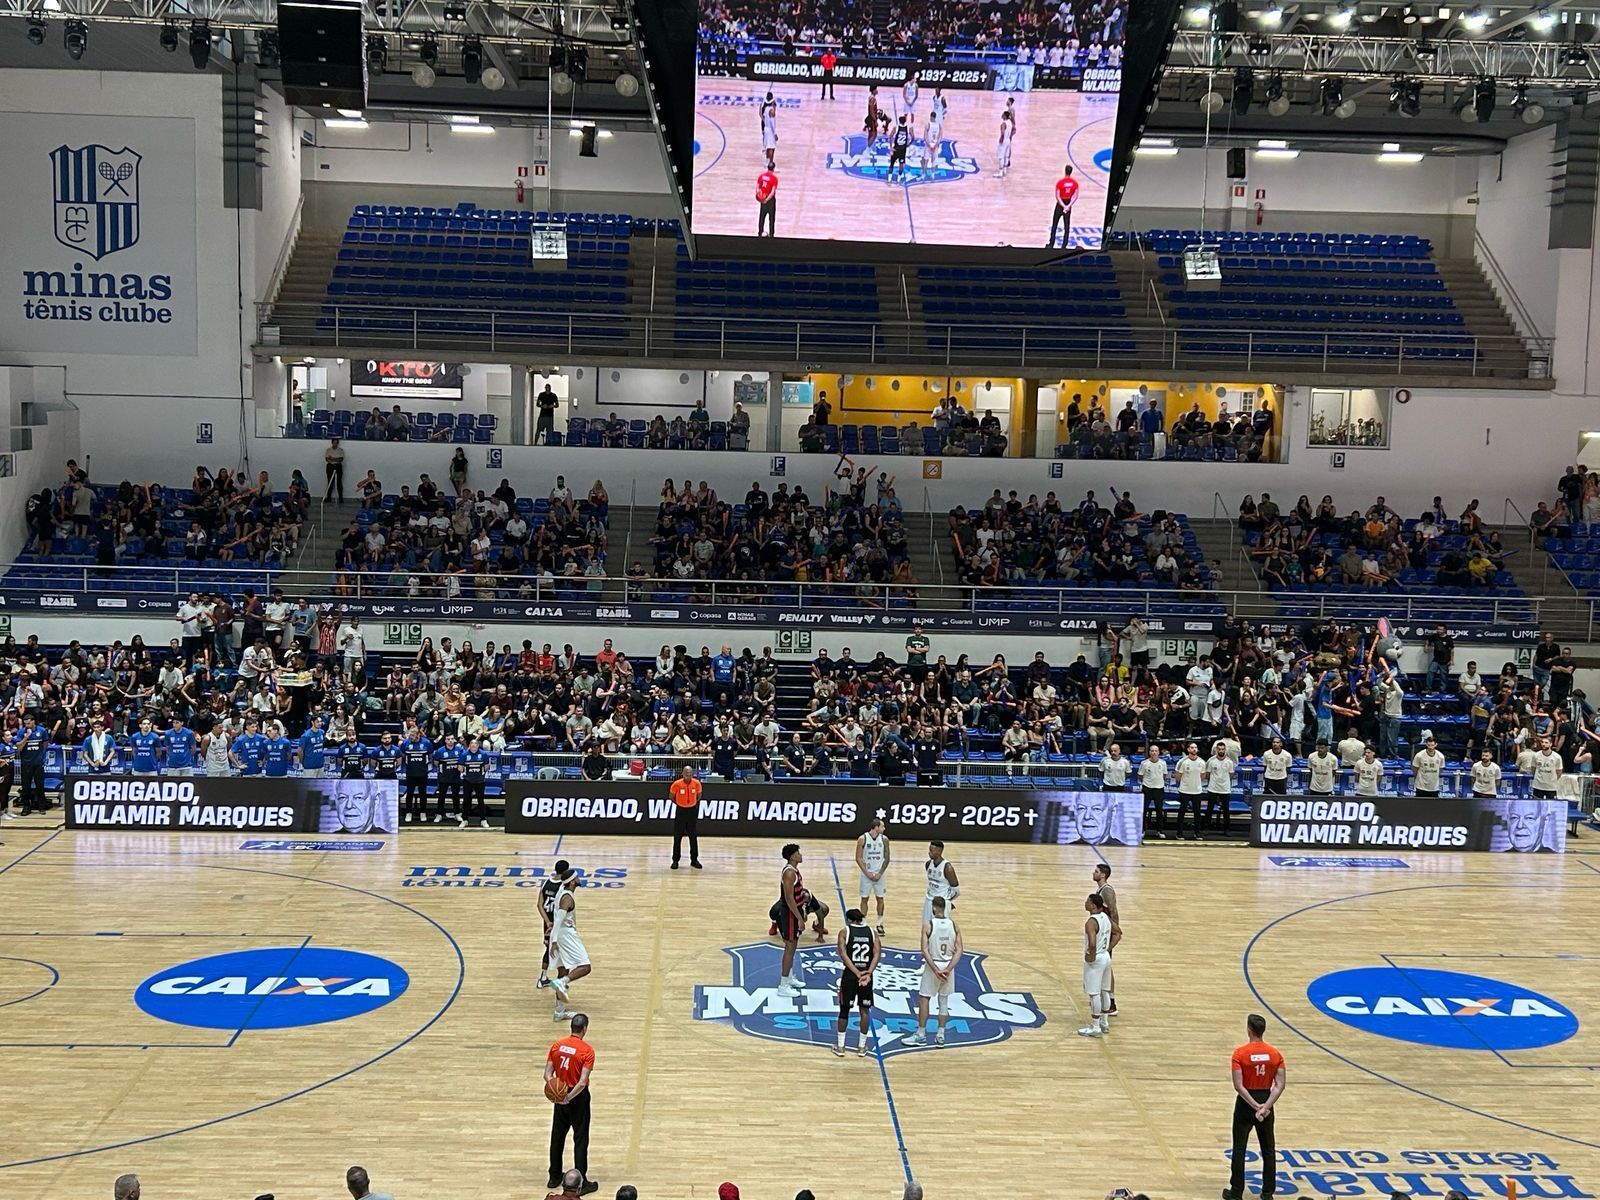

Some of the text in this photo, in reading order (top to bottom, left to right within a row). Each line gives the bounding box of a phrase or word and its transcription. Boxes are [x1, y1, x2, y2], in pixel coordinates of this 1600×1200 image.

[754, 62, 810, 78] OBRIGADO,
[812, 64, 854, 78] WMIR
[856, 67, 907, 81] MARQUES
[22, 262, 172, 300] minas
[23, 298, 172, 323] tênis clube
[378, 360, 437, 378] KTO
[201, 424, 211, 435] H
[491, 450, 501, 461] G
[1335, 454, 1344, 464] D
[776, 458, 783, 468] F
[1053, 464, 1062, 474] E
[40, 597, 77, 607] BRASIL
[441, 605, 474, 615] UMP
[525, 607, 563, 617] CAIXA
[596, 608, 632, 618] BRASIL
[778, 613, 823, 623] PENALTY
[978, 618, 1011, 627] UMP
[389, 625, 401, 635] D
[409, 625, 421, 635] C
[1060, 620, 1097, 629] CAIXA
[780, 631, 792, 642] C
[801, 631, 811, 642] B
[1484, 630, 1507, 638] Guarani
[1167, 641, 1176, 651] B
[1186, 641, 1197, 651] A
[1519, 648, 1530, 658] A
[73, 780, 200, 805] OBRIGADO,
[74, 804, 294, 828] WLAMIR MARQUES
[521, 797, 644, 822] OBRIGADO,
[648, 799, 739, 820] WMIR
[747, 800, 857, 825] MARQUES
[1260, 800, 1380, 824] OBRIGADO,
[1260, 823, 1468, 847] WLAMIR MARQUES
[401, 877, 505, 888] tênis
[852, 943, 870, 962] 22
[940, 943, 947, 956] 9
[150, 976, 390, 996] CAIXA
[1325, 995, 1567, 1017] CAIXA
[560, 1055, 570, 1070] 74
[1254, 1063, 1266, 1076] 14
[1400, 1149, 1559, 1171] tênis
